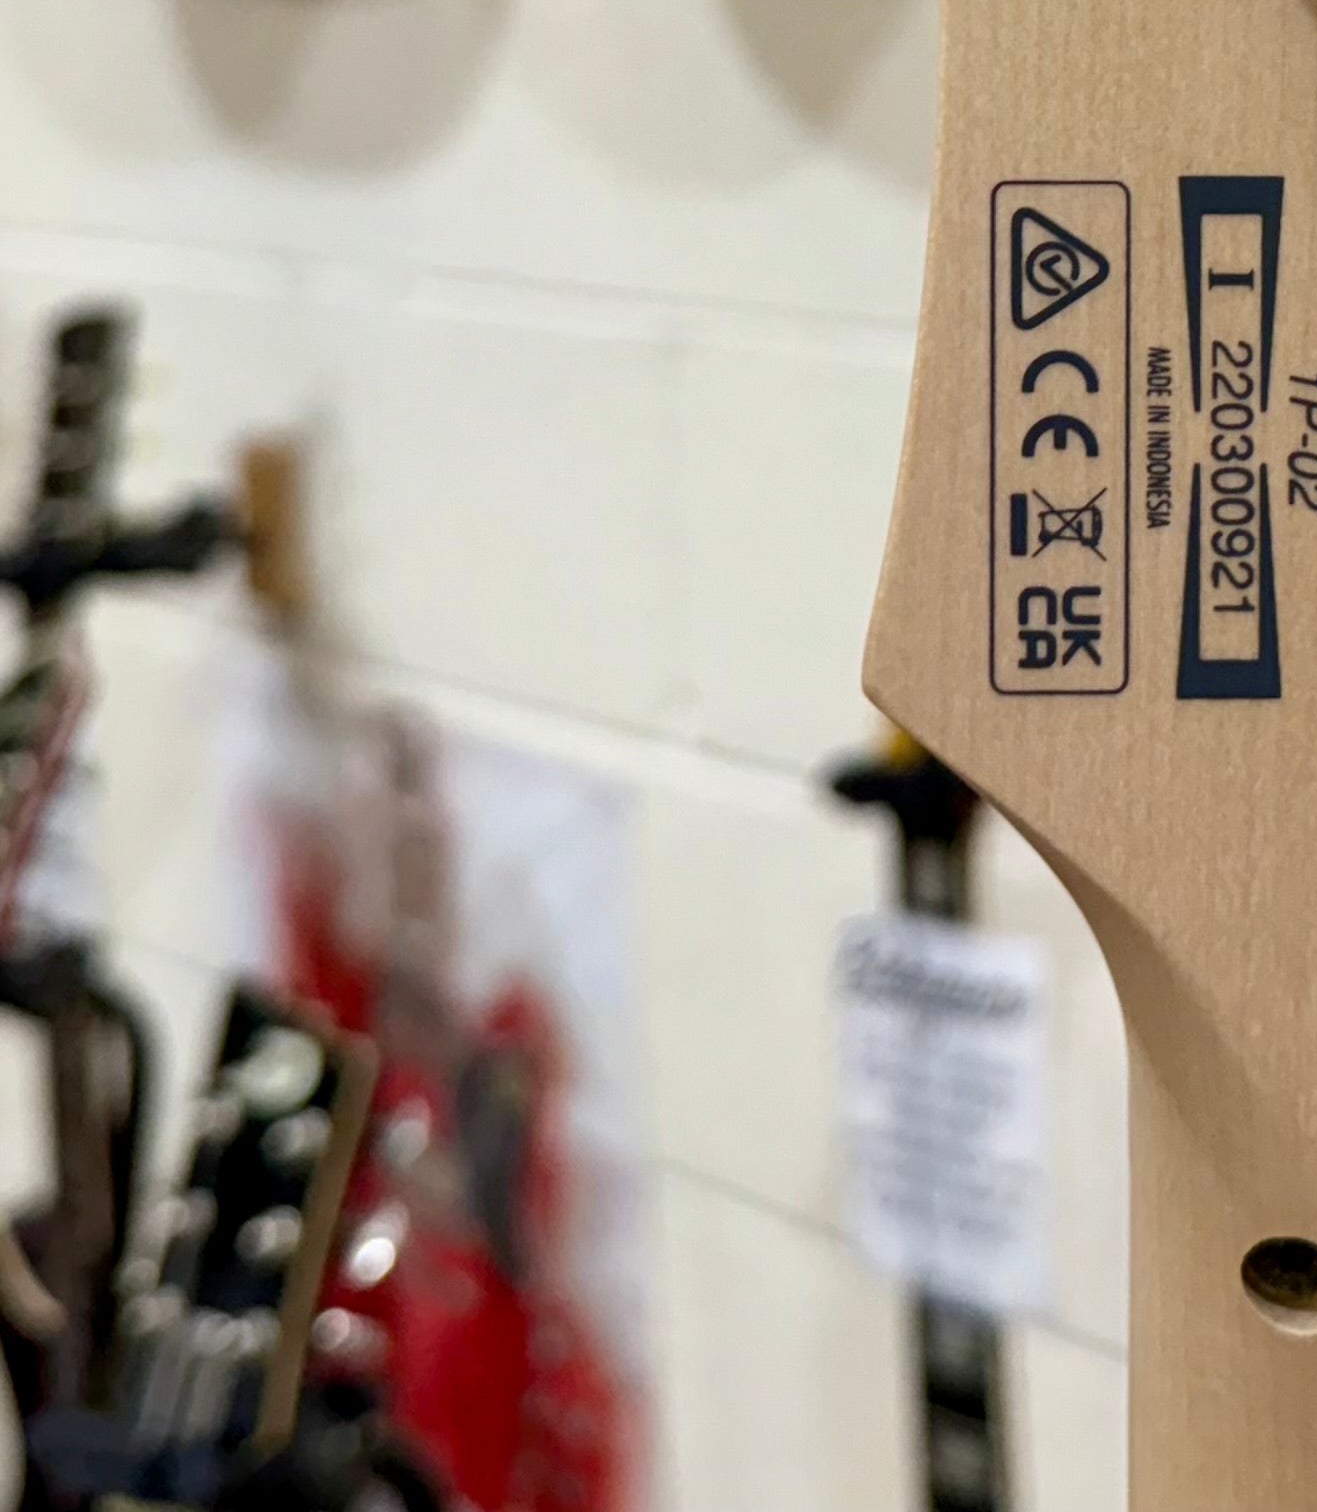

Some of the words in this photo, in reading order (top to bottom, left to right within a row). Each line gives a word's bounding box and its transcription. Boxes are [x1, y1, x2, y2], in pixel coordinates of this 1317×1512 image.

[1208, 268, 1254, 291] I
[1021, 349, 1099, 458] CE
[1147, 347, 1172, 396] MADE
[1147, 405, 1171, 423] IN
[1146, 431, 1172, 529] INDONESIA
[1210, 340, 1255, 613] 220300921
[1018, 586, 1057, 669] CA
[1062, 586, 1102, 666] UK
